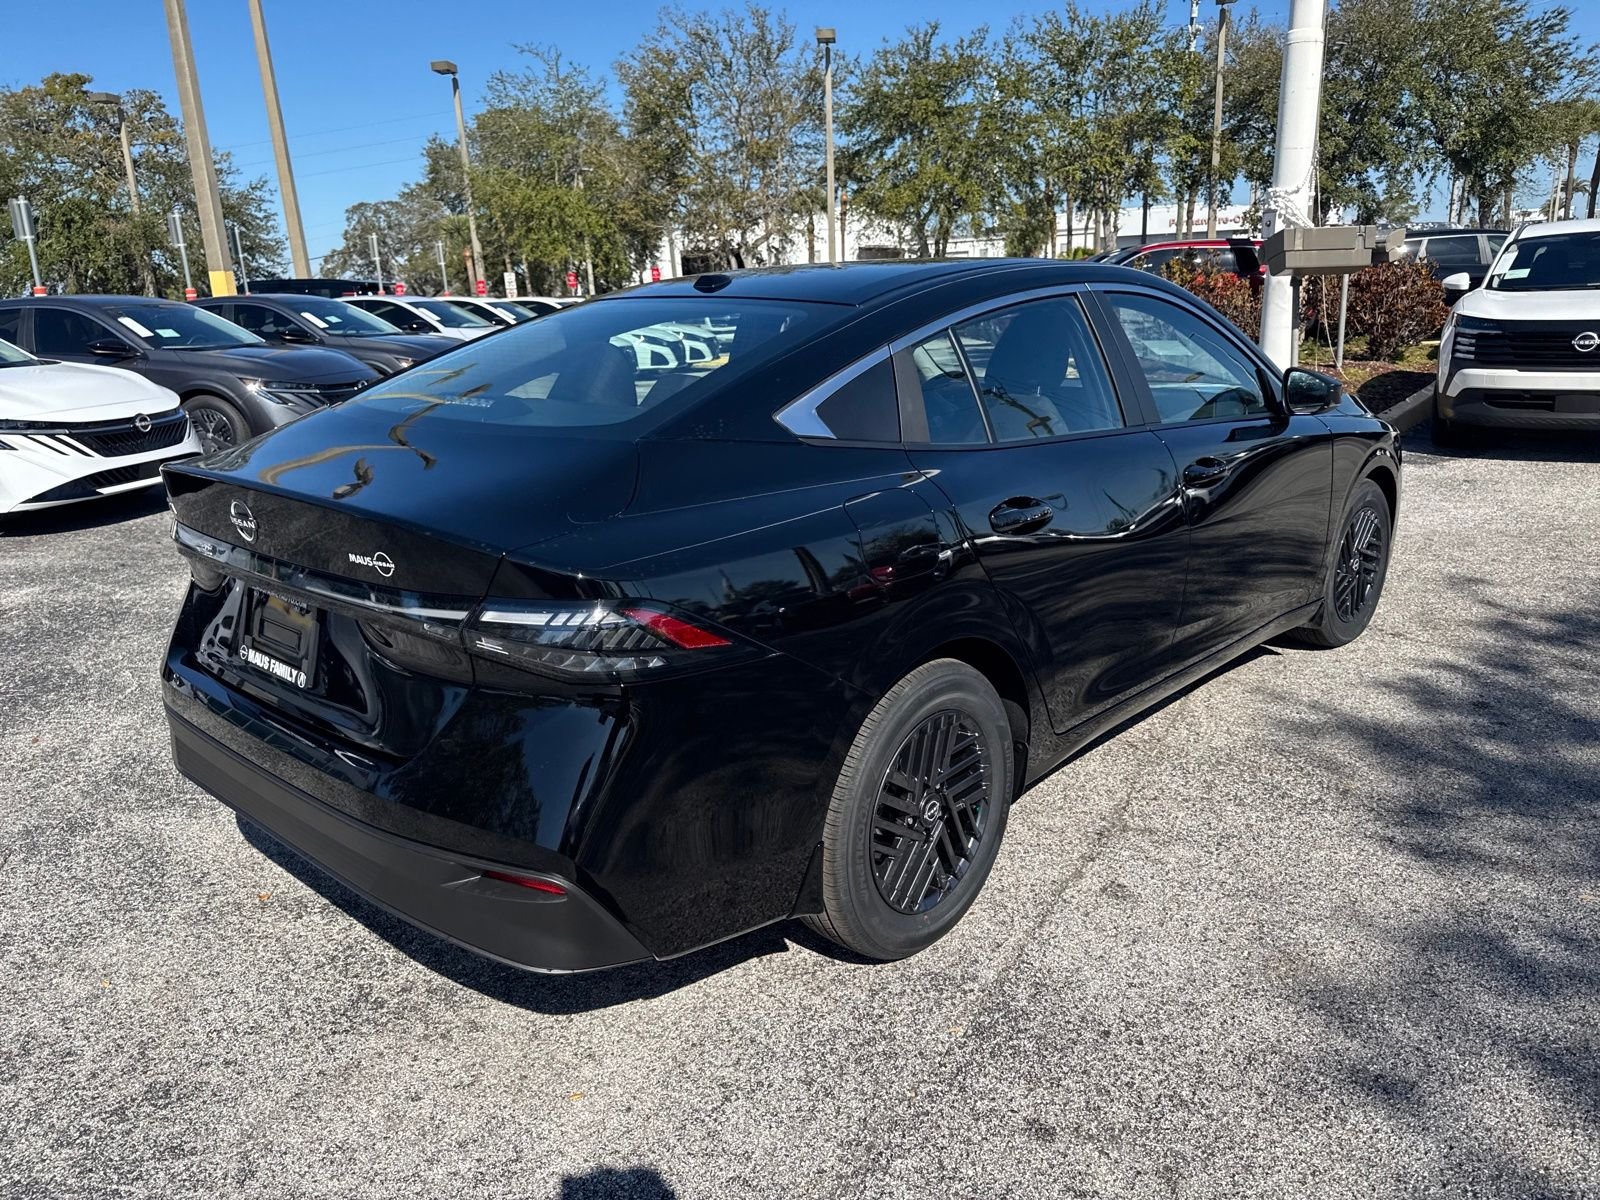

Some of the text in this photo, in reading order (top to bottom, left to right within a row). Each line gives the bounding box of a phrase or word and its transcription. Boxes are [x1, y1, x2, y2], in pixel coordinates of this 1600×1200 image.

[348, 553, 395, 569] MAUS NISSAN
[247, 648, 299, 683] MAUS FAMILY
